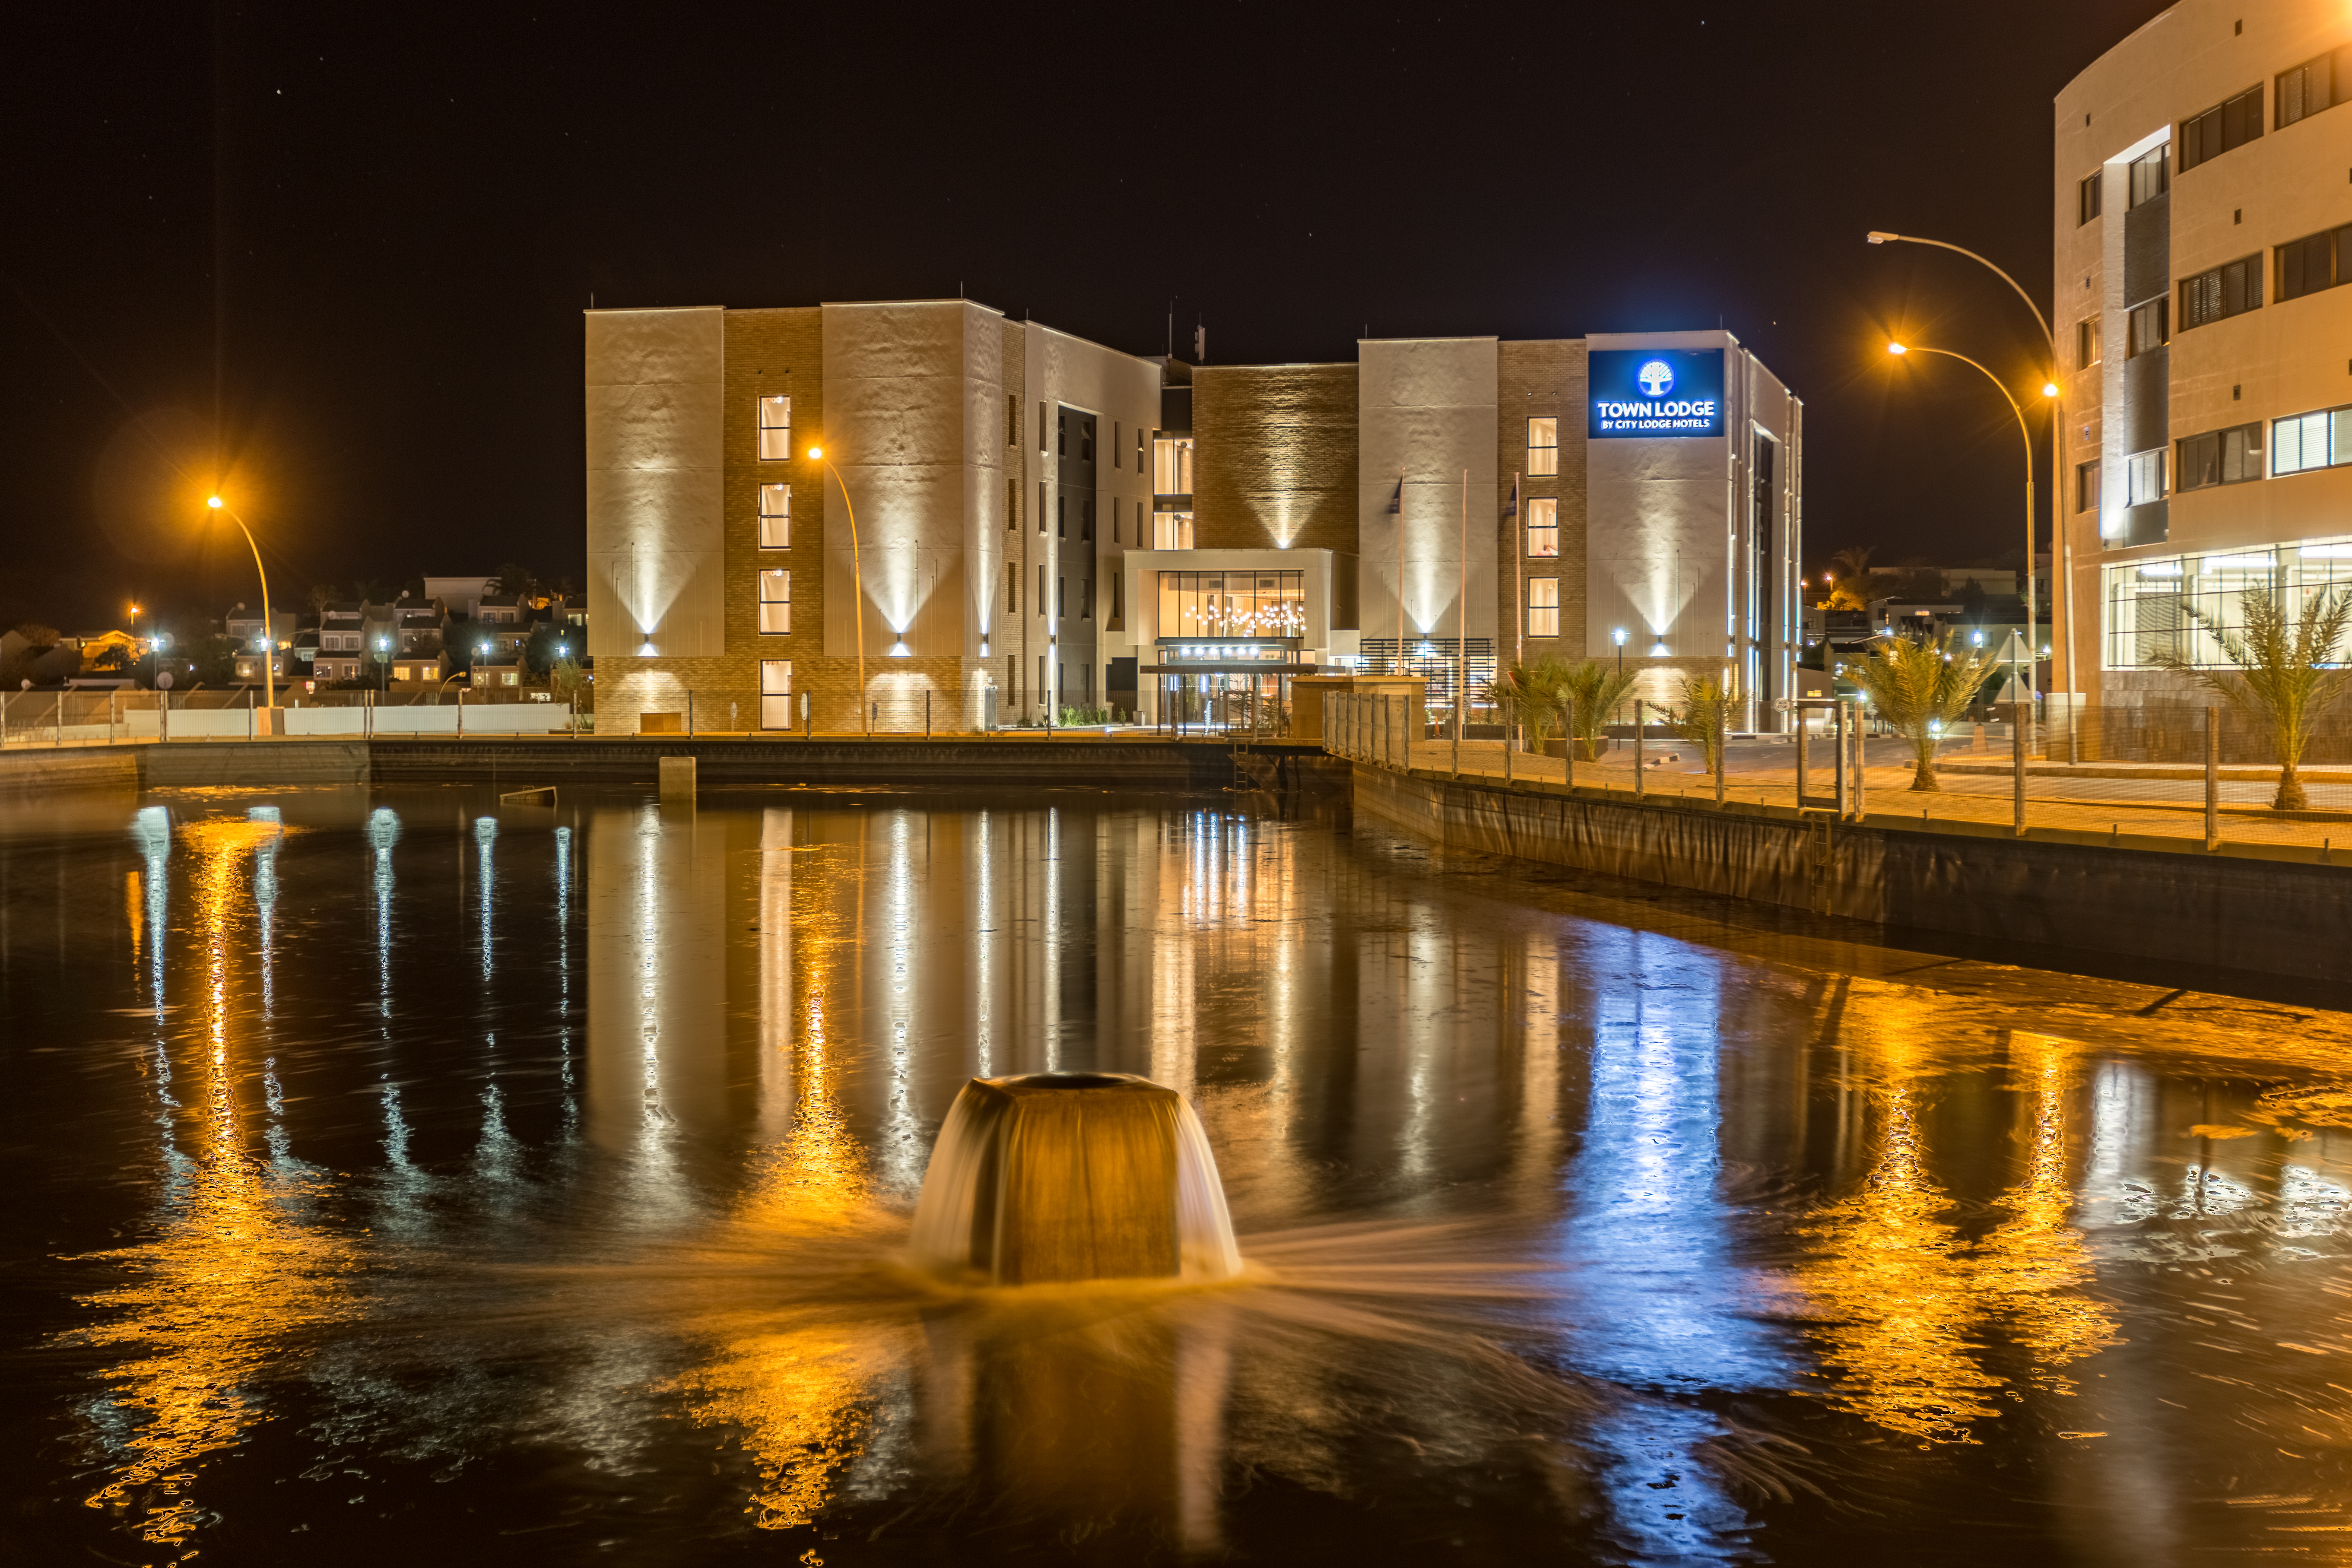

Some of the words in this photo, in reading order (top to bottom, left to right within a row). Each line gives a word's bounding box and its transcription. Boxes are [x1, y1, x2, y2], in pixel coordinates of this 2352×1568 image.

[1597, 402, 1652, 418] TOWN
[1655, 401, 1714, 417] LODGE
[1602, 420, 1614, 429] BY
[1616, 420, 1638, 429] CITY
[1639, 420, 1672, 429] LODGE
[1673, 419, 1709, 428] HOTELS
